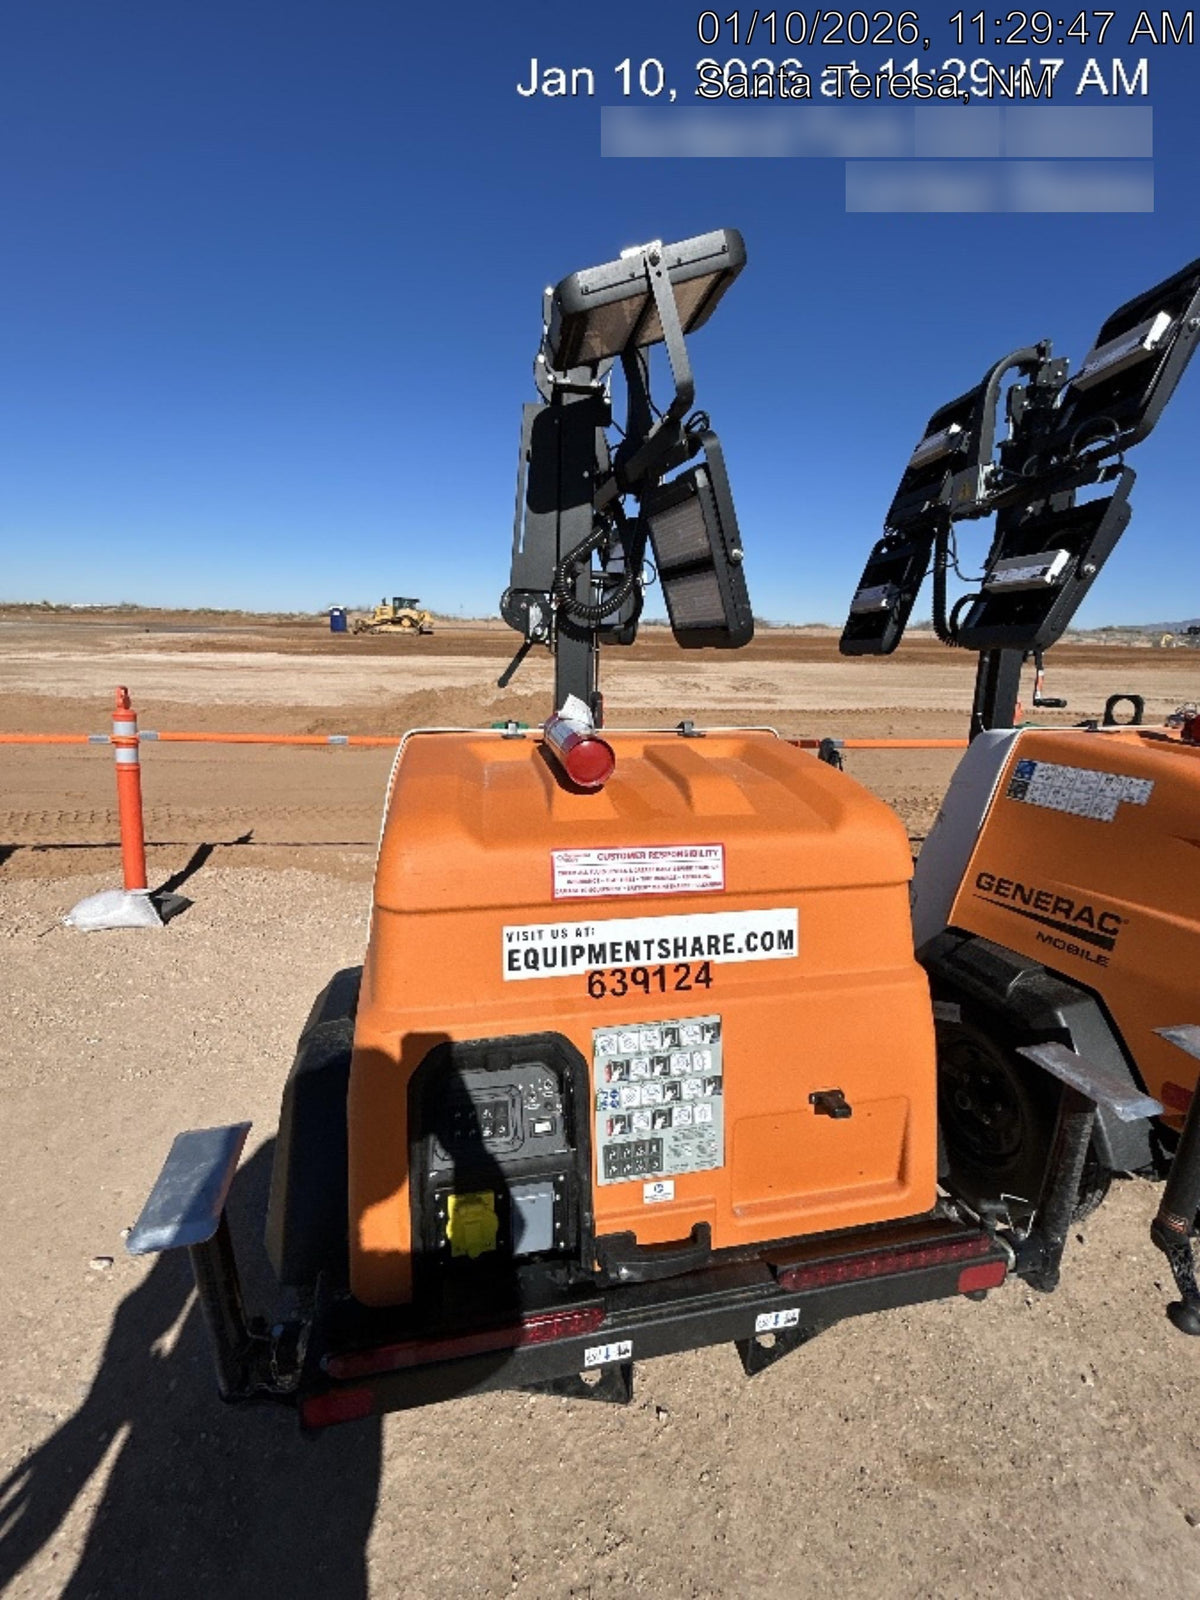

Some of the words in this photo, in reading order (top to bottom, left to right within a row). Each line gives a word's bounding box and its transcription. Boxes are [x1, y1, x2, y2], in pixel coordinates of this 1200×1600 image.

[975, 872, 1124, 936] GENERAC
[506, 929, 544, 943] VISIT
[551, 927, 568, 940] US
[575, 926, 596, 938] AT:
[507, 928, 795, 972] EQUIPMENTSHARE.COM
[1035, 931, 1112, 969] MOBILE
[587, 961, 713, 999] 639124
